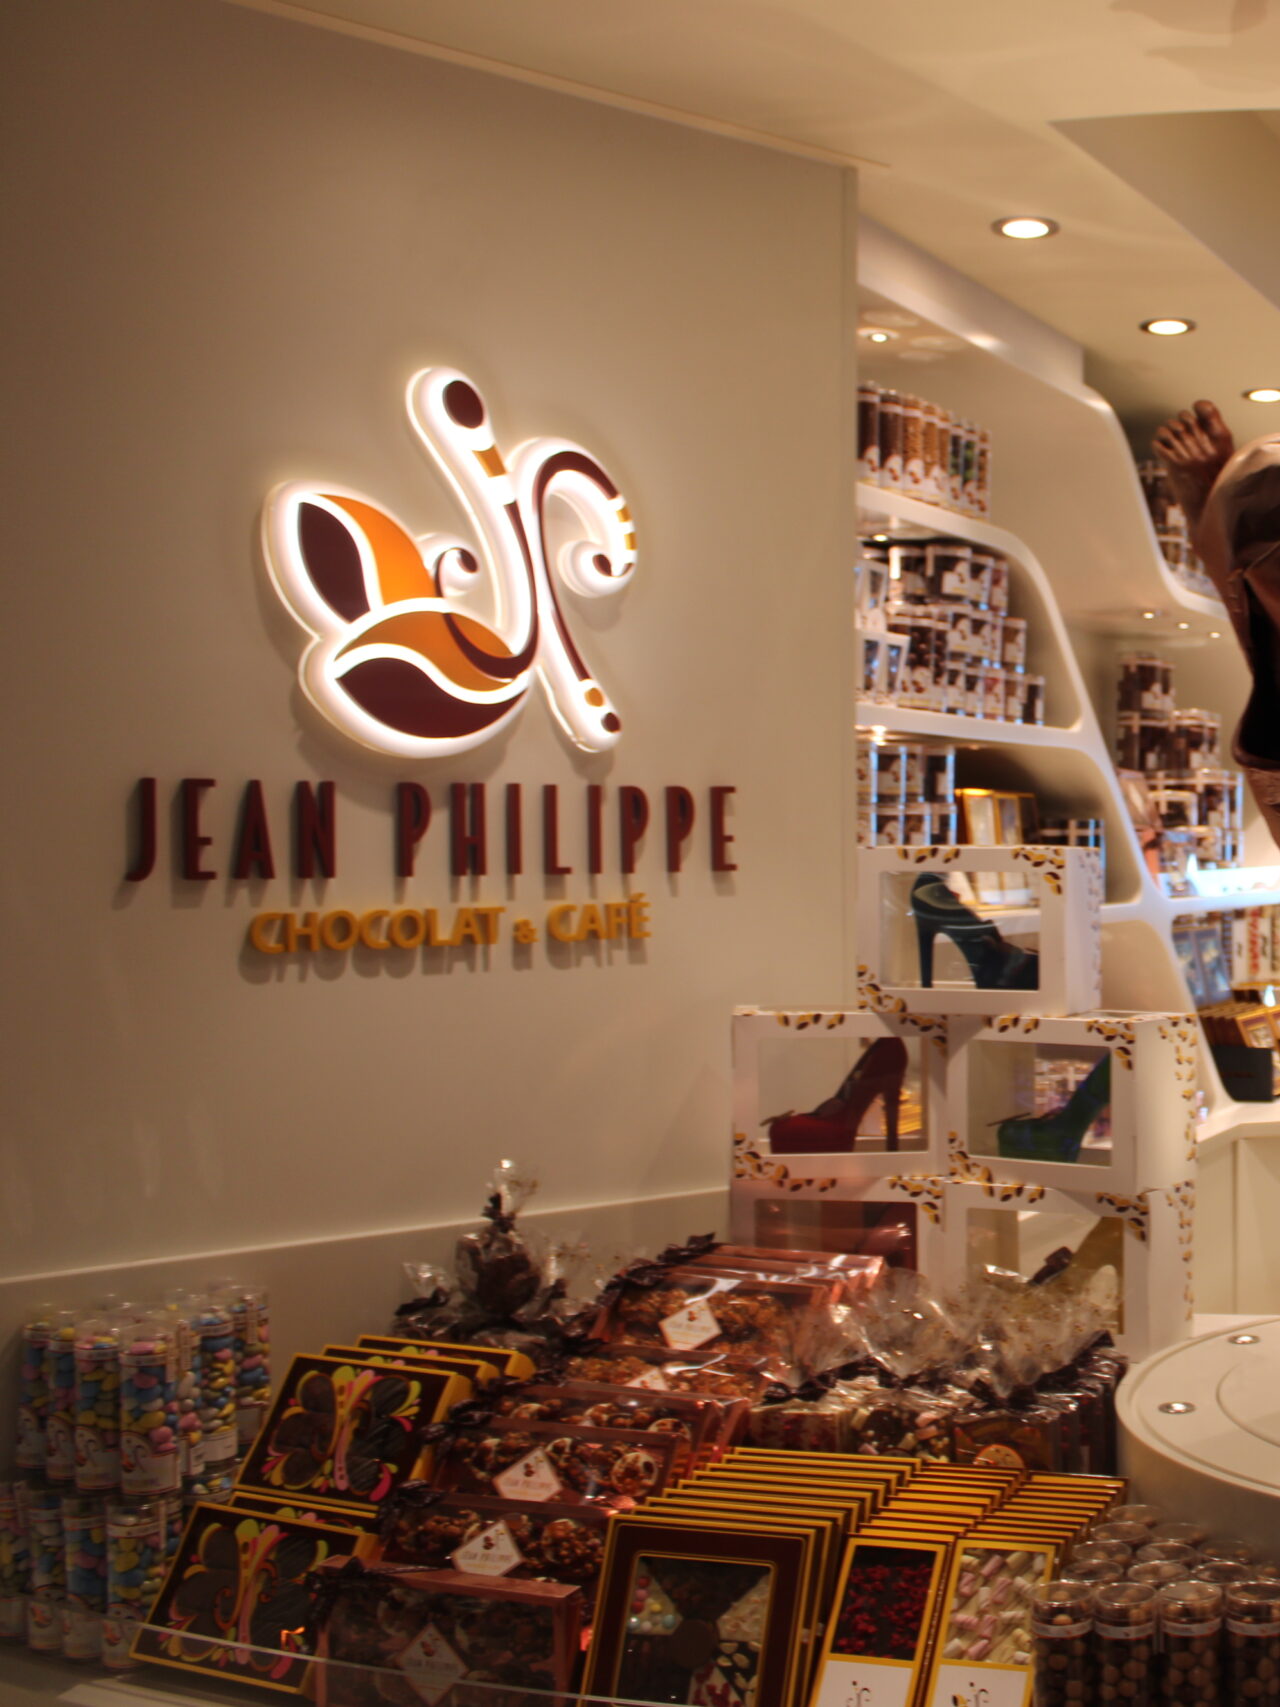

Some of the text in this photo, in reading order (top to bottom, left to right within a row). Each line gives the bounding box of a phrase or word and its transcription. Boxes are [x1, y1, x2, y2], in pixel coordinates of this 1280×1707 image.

[124, 777, 737, 882] JEAN PHILIPPE
[250, 893, 652, 954] CHOCOLAT & CAFÉ
